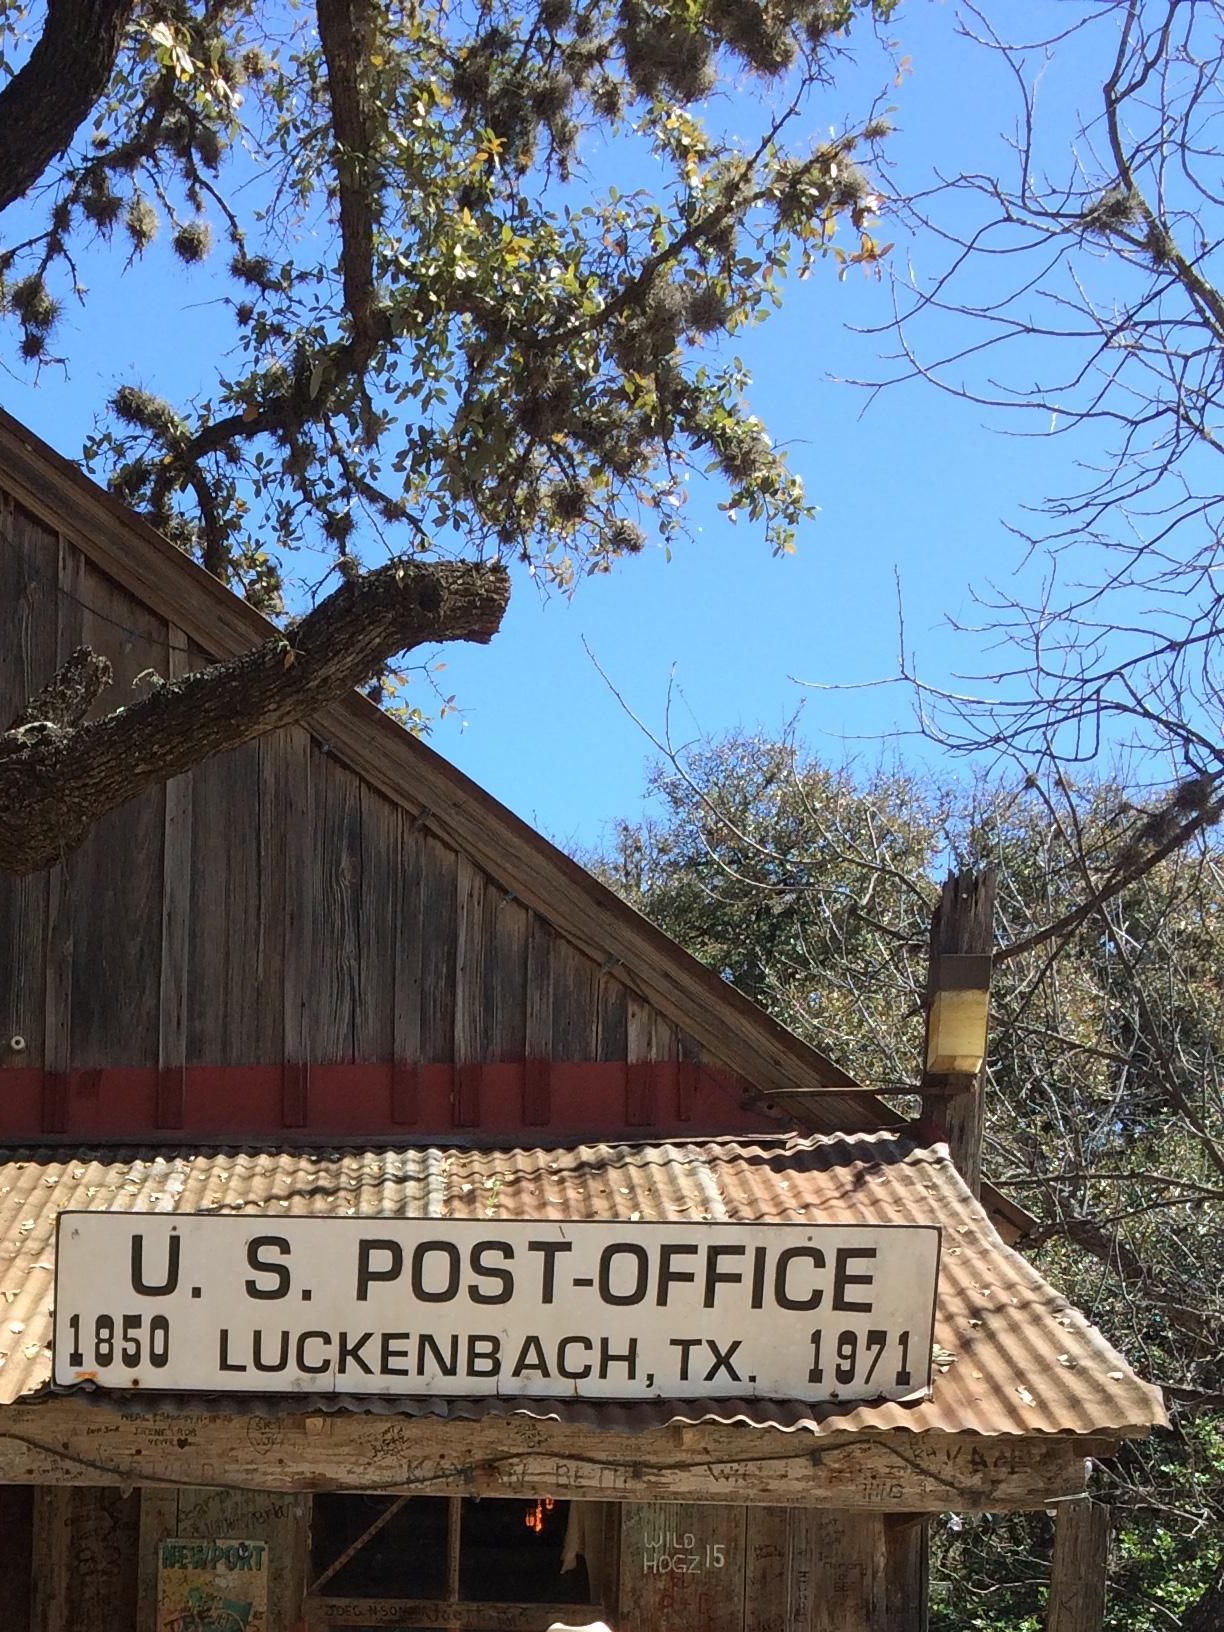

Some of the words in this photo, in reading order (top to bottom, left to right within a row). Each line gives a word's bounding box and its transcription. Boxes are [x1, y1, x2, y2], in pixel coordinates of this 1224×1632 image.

[130, 1234, 202, 1299] U.
[244, 1235, 312, 1302] S.
[355, 1238, 877, 1314] POST-OFFICE
[68, 1313, 170, 1369] 1850
[218, 1328, 656, 1389] LUCKENBACH,
[668, 1338, 758, 1384] TX.
[806, 1328, 912, 1387] 1971
[643, 1531, 697, 1550] WILD
[161, 1543, 266, 1572] NEWPORT
[642, 1551, 702, 1575] HOGZ
[705, 1544, 726, 1569] 15
